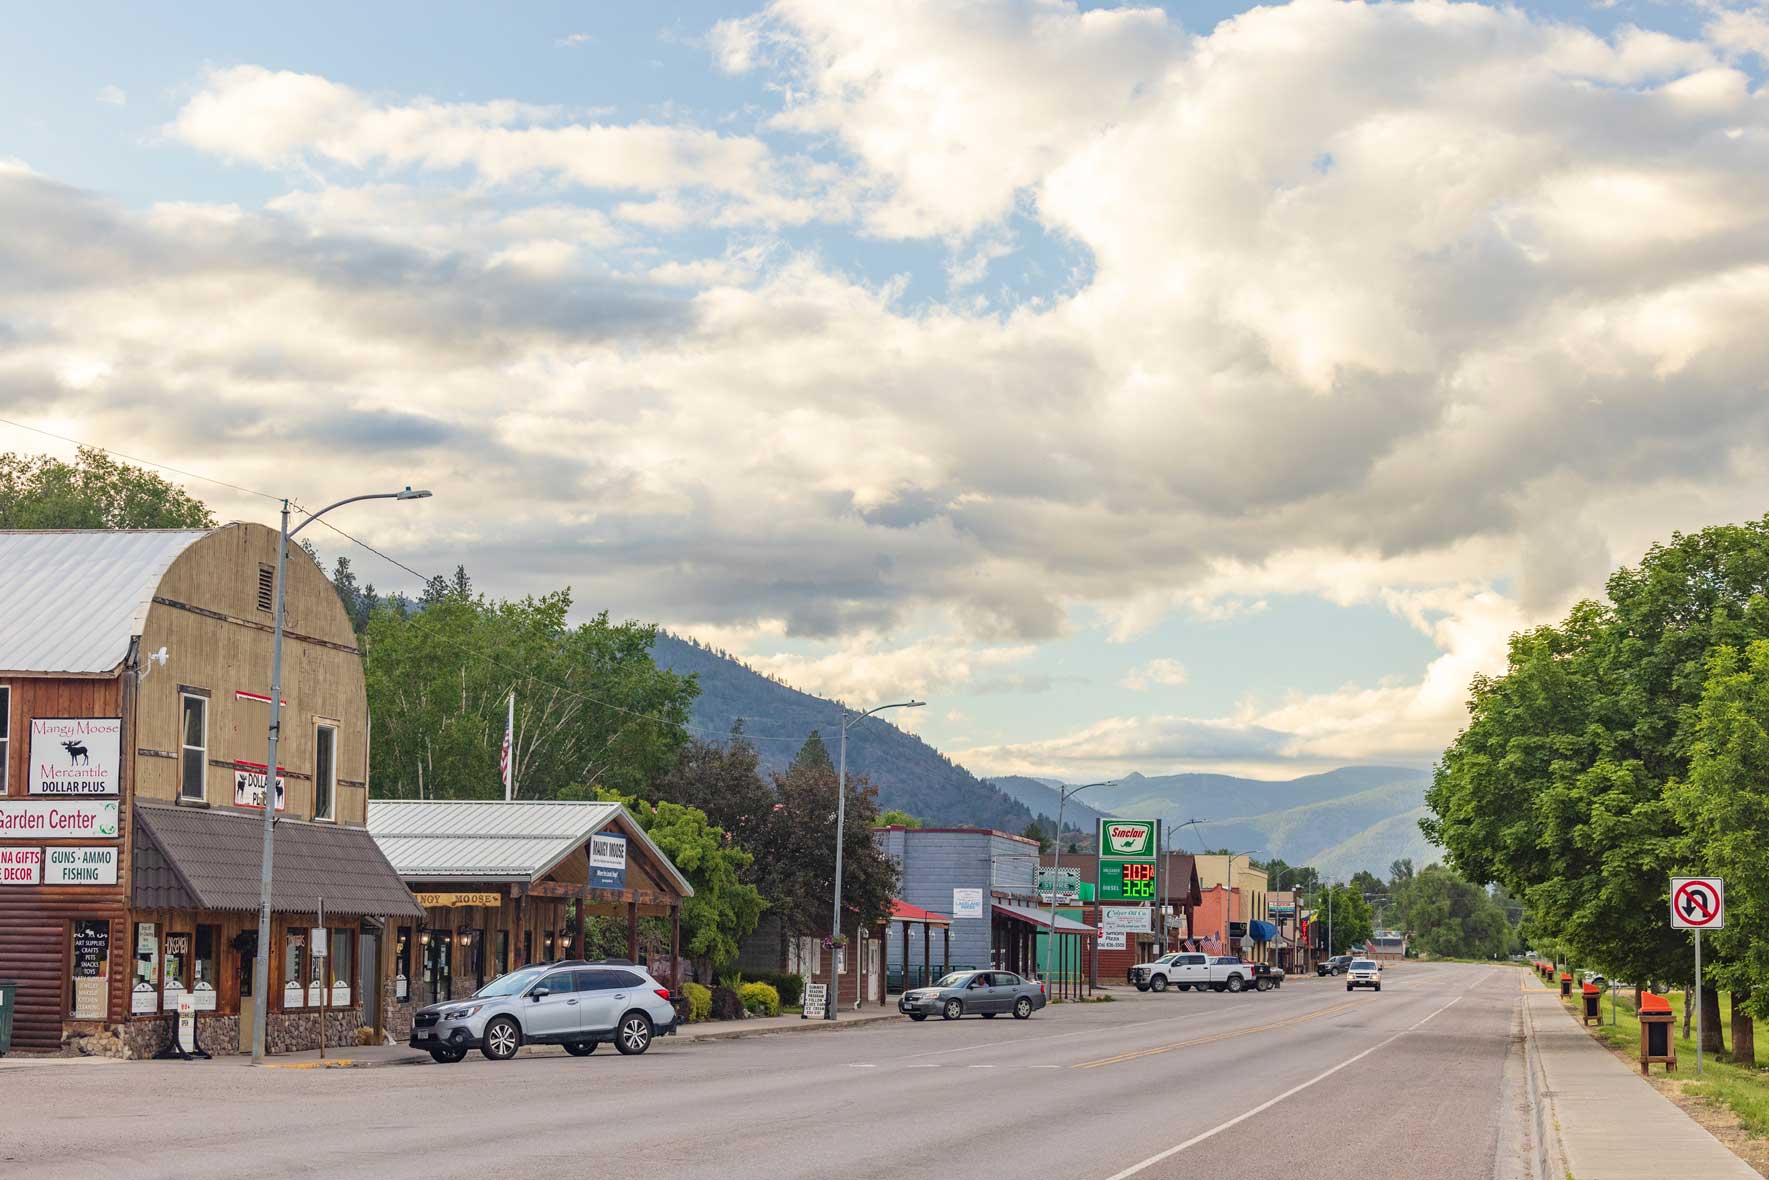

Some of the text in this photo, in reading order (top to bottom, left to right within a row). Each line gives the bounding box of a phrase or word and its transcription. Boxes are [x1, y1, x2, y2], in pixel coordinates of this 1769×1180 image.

[33, 721, 119, 737] Mangy Moose
[40, 764, 108, 779] Mercantile
[42, 781, 105, 793] DOLLAR PLUS
[248, 773, 268, 788] DOLLA
[49, 809, 97, 829] Center
[1112, 827, 1145, 838] Sinclair
[592, 840, 625, 858] MANGY MOOSE
[15, 851, 40, 864] GIFTS
[51, 851, 111, 864] GUNS AMMO
[4, 868, 33, 880] DECOR
[63, 868, 99, 880] FISHING
[415, 895, 491, 904] NGY MOOSE
